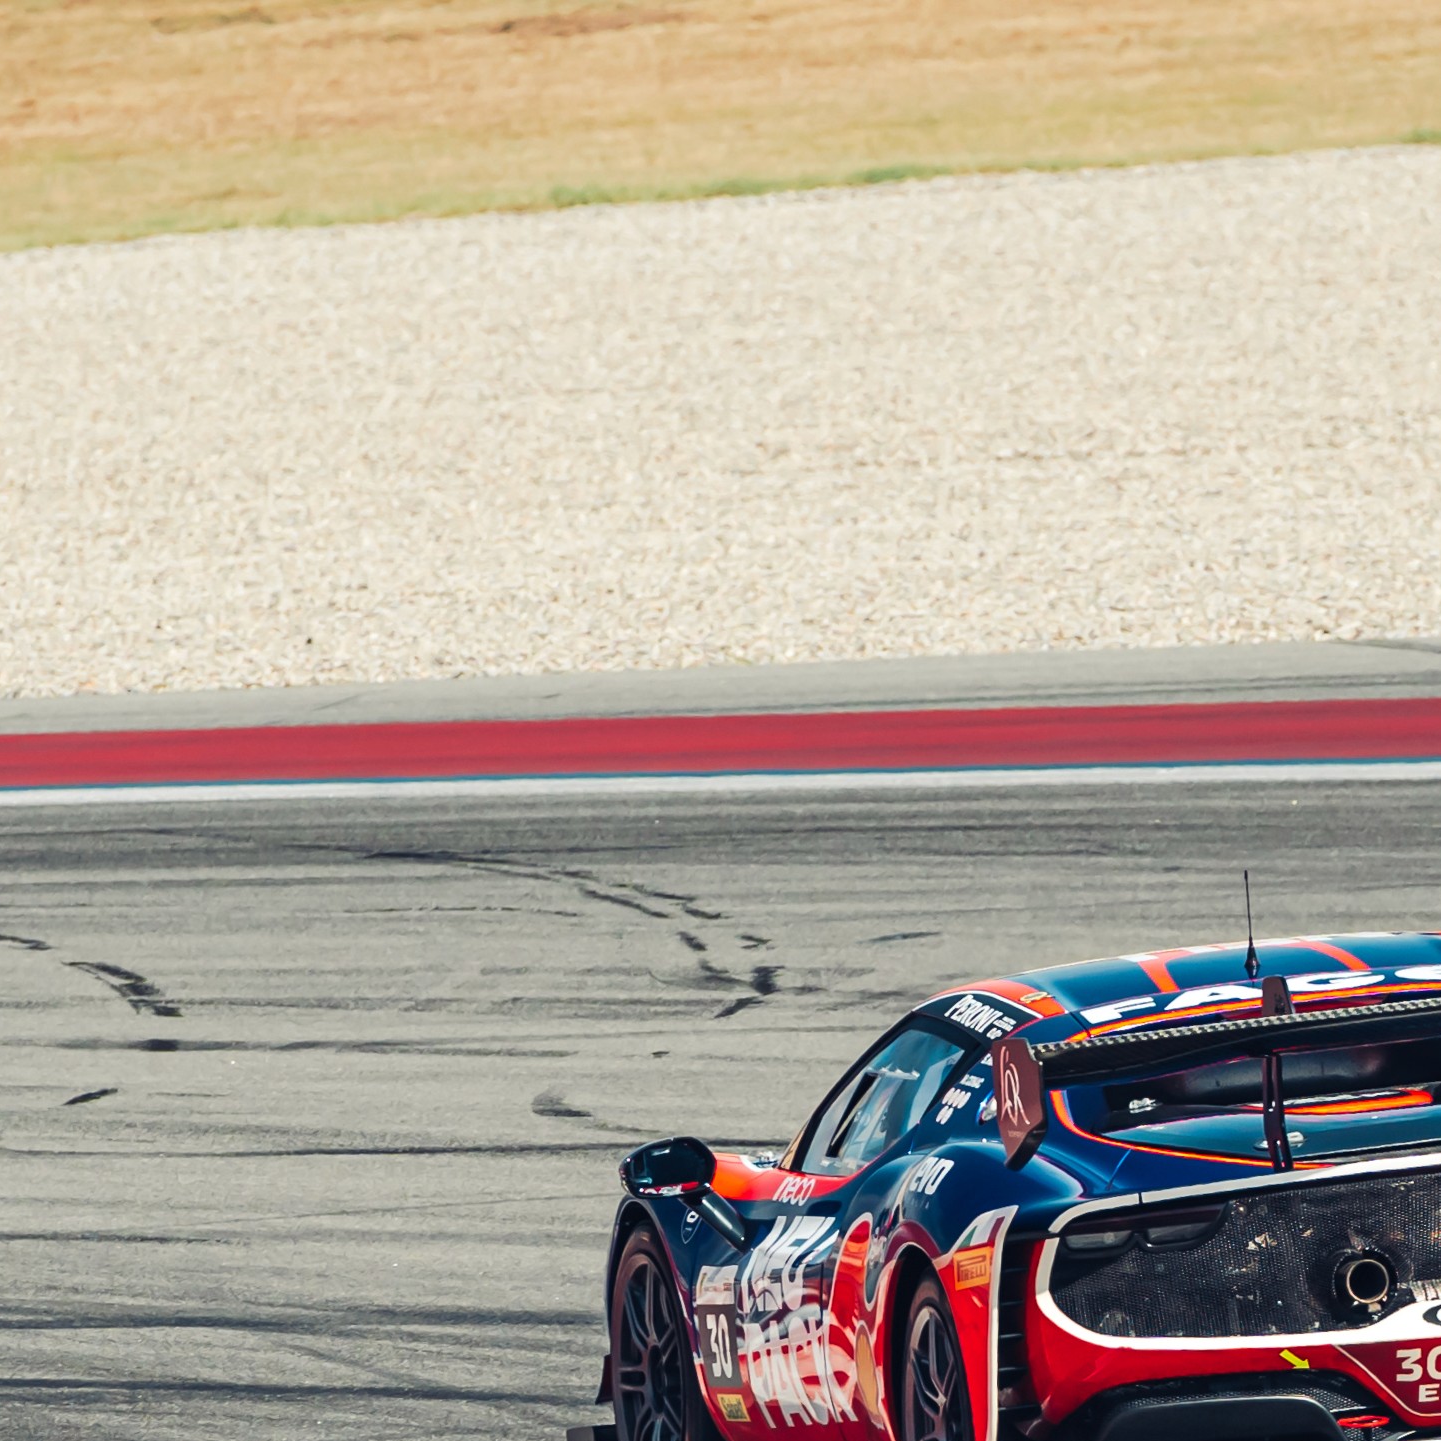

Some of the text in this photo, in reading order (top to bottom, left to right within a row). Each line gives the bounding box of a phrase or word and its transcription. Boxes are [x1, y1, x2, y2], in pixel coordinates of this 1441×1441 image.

[944, 994, 1004, 1033] PERONI
[957, 1255, 987, 1282] PIRELLI
[706, 1313, 732, 1379] 30
[745, 1317, 859, 1429] PACK
